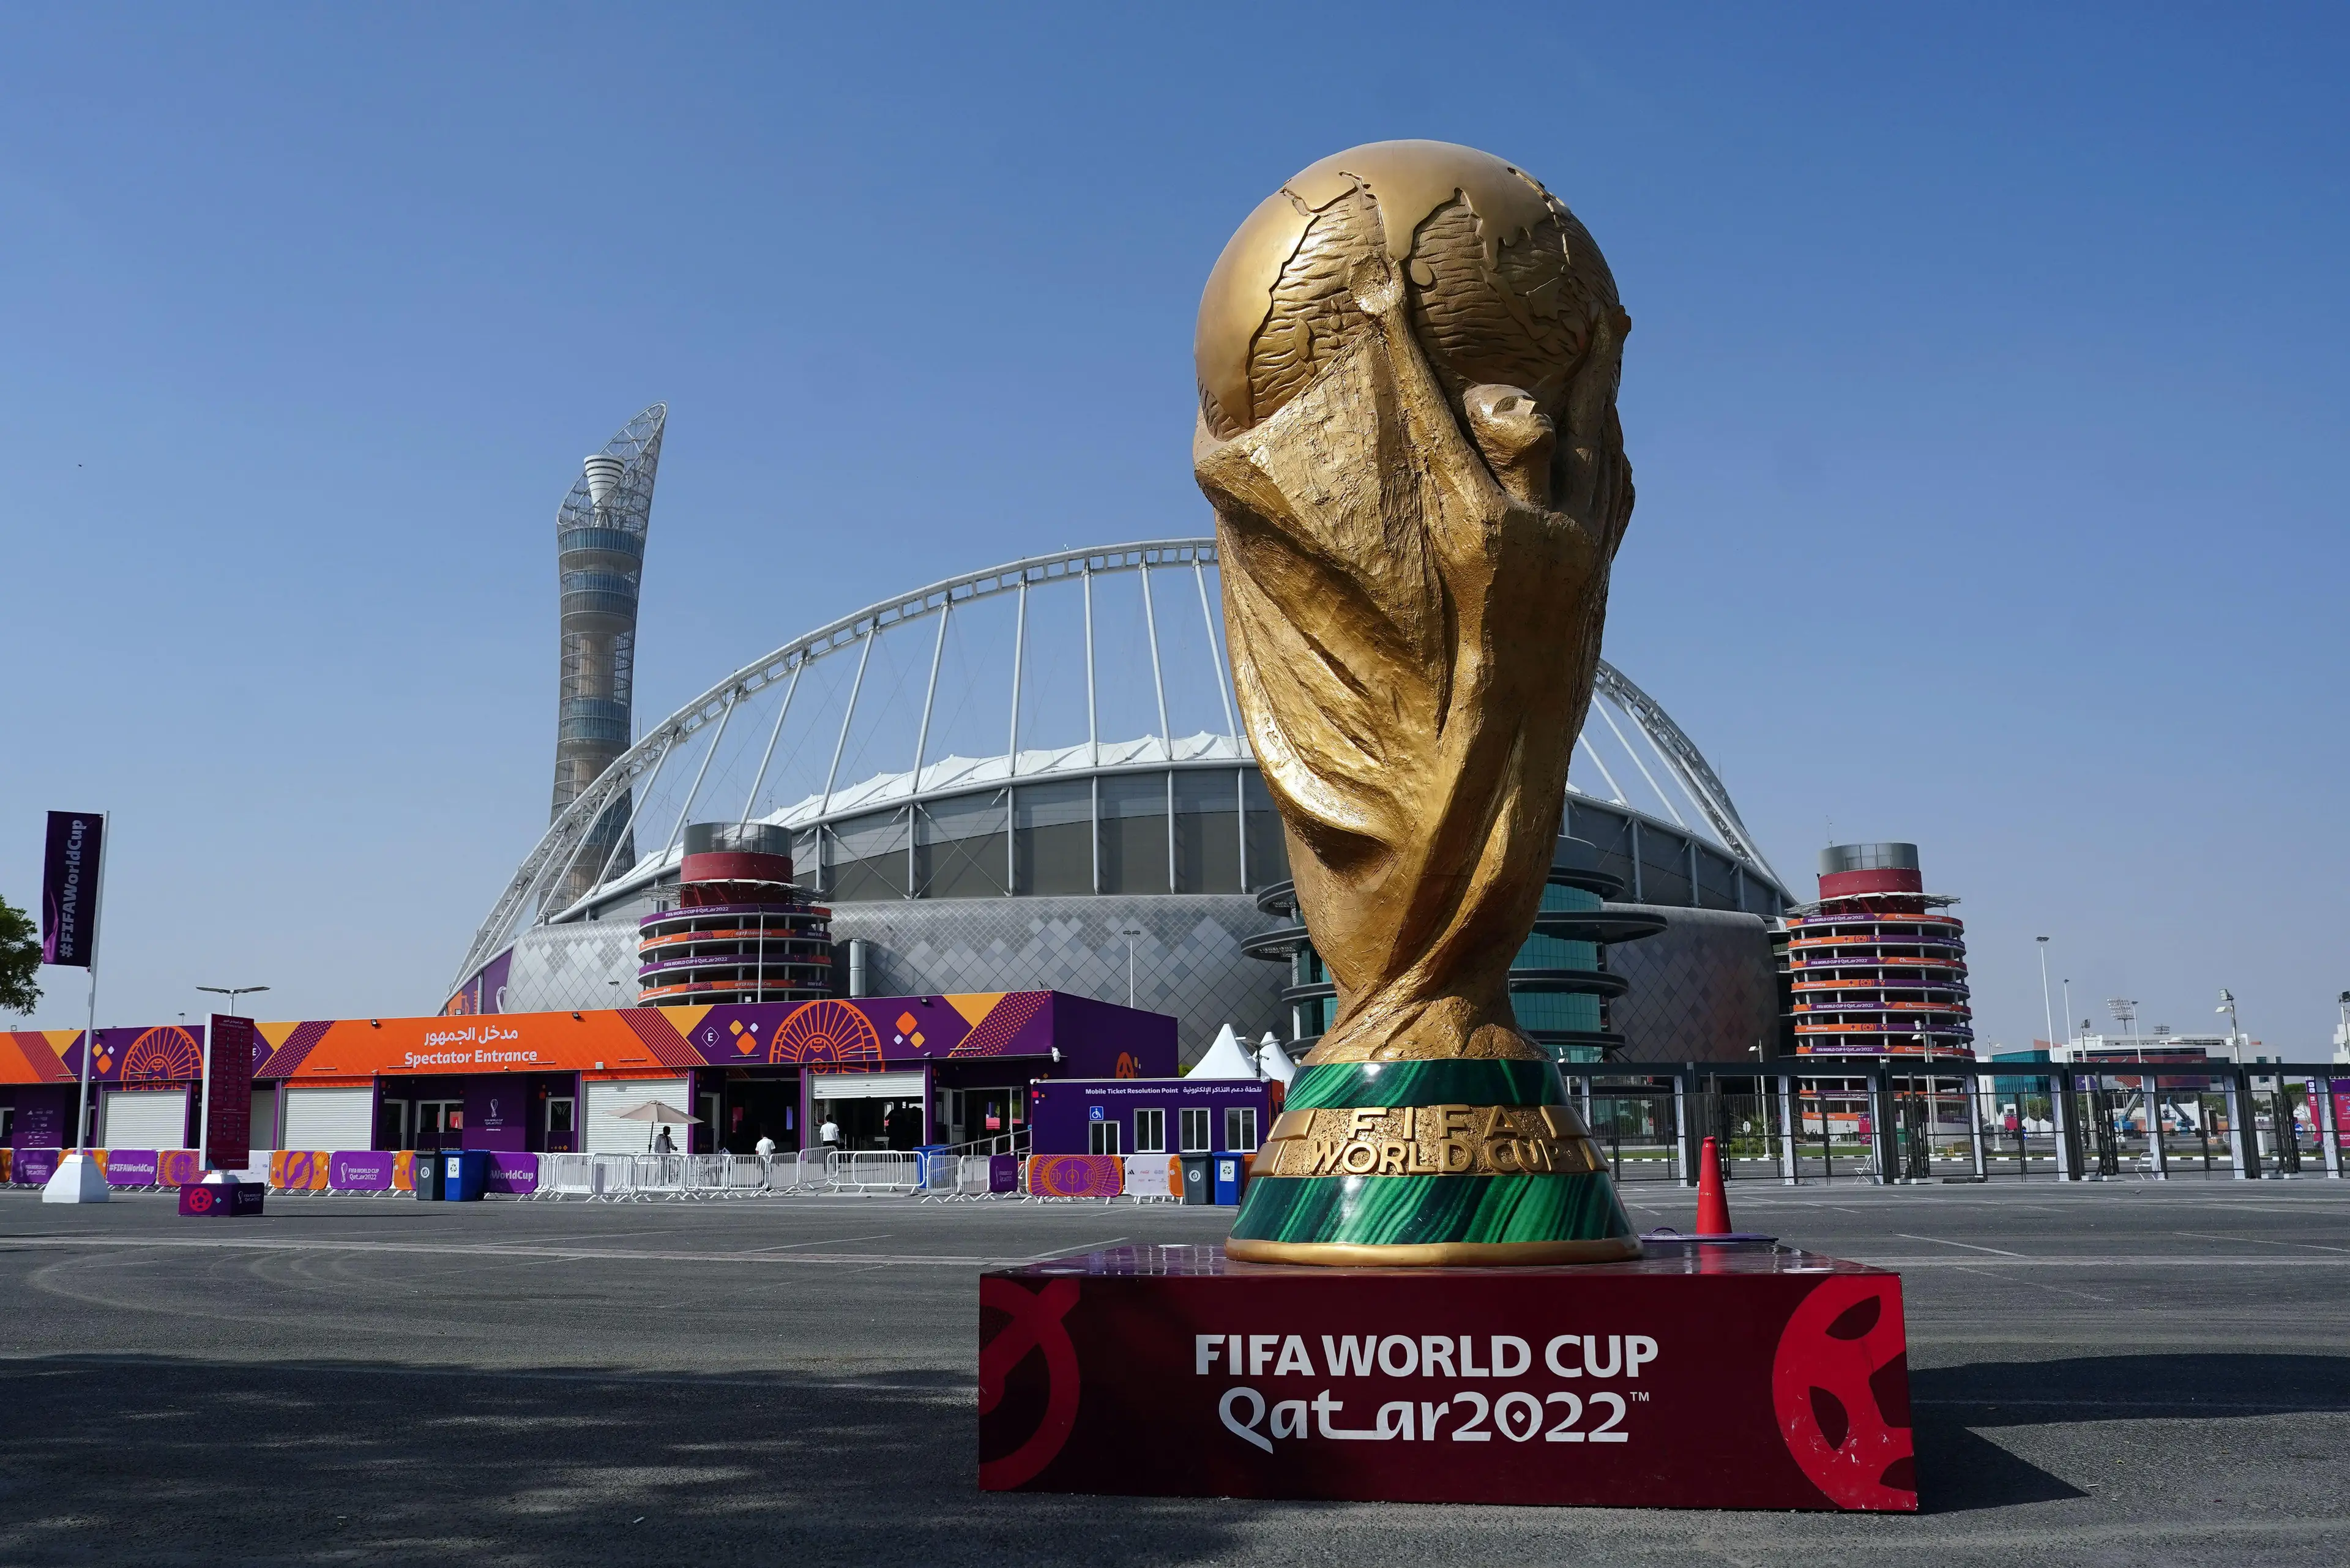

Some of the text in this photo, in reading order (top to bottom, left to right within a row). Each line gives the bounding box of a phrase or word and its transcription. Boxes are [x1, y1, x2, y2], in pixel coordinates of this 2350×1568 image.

[59, 819, 88, 958] #FIFAWorldCup
[424, 1025, 518, 1046] مدخل الجمهور
[707, 1032, 714, 1042] E
[252, 1048, 256, 1056] E
[404, 1050, 538, 1068] Spectator Entrance
[1348, 1104, 1530, 1141] FIFA
[1308, 1138, 1564, 1175] WORLD CUP
[109, 1163, 155, 1174] #FIFAWorldCup
[490, 1169, 534, 1182] WorldCup
[1195, 1334, 1658, 1378] FIFA WORLD CUP
[1219, 1386, 1629, 1455] Qatar2022
